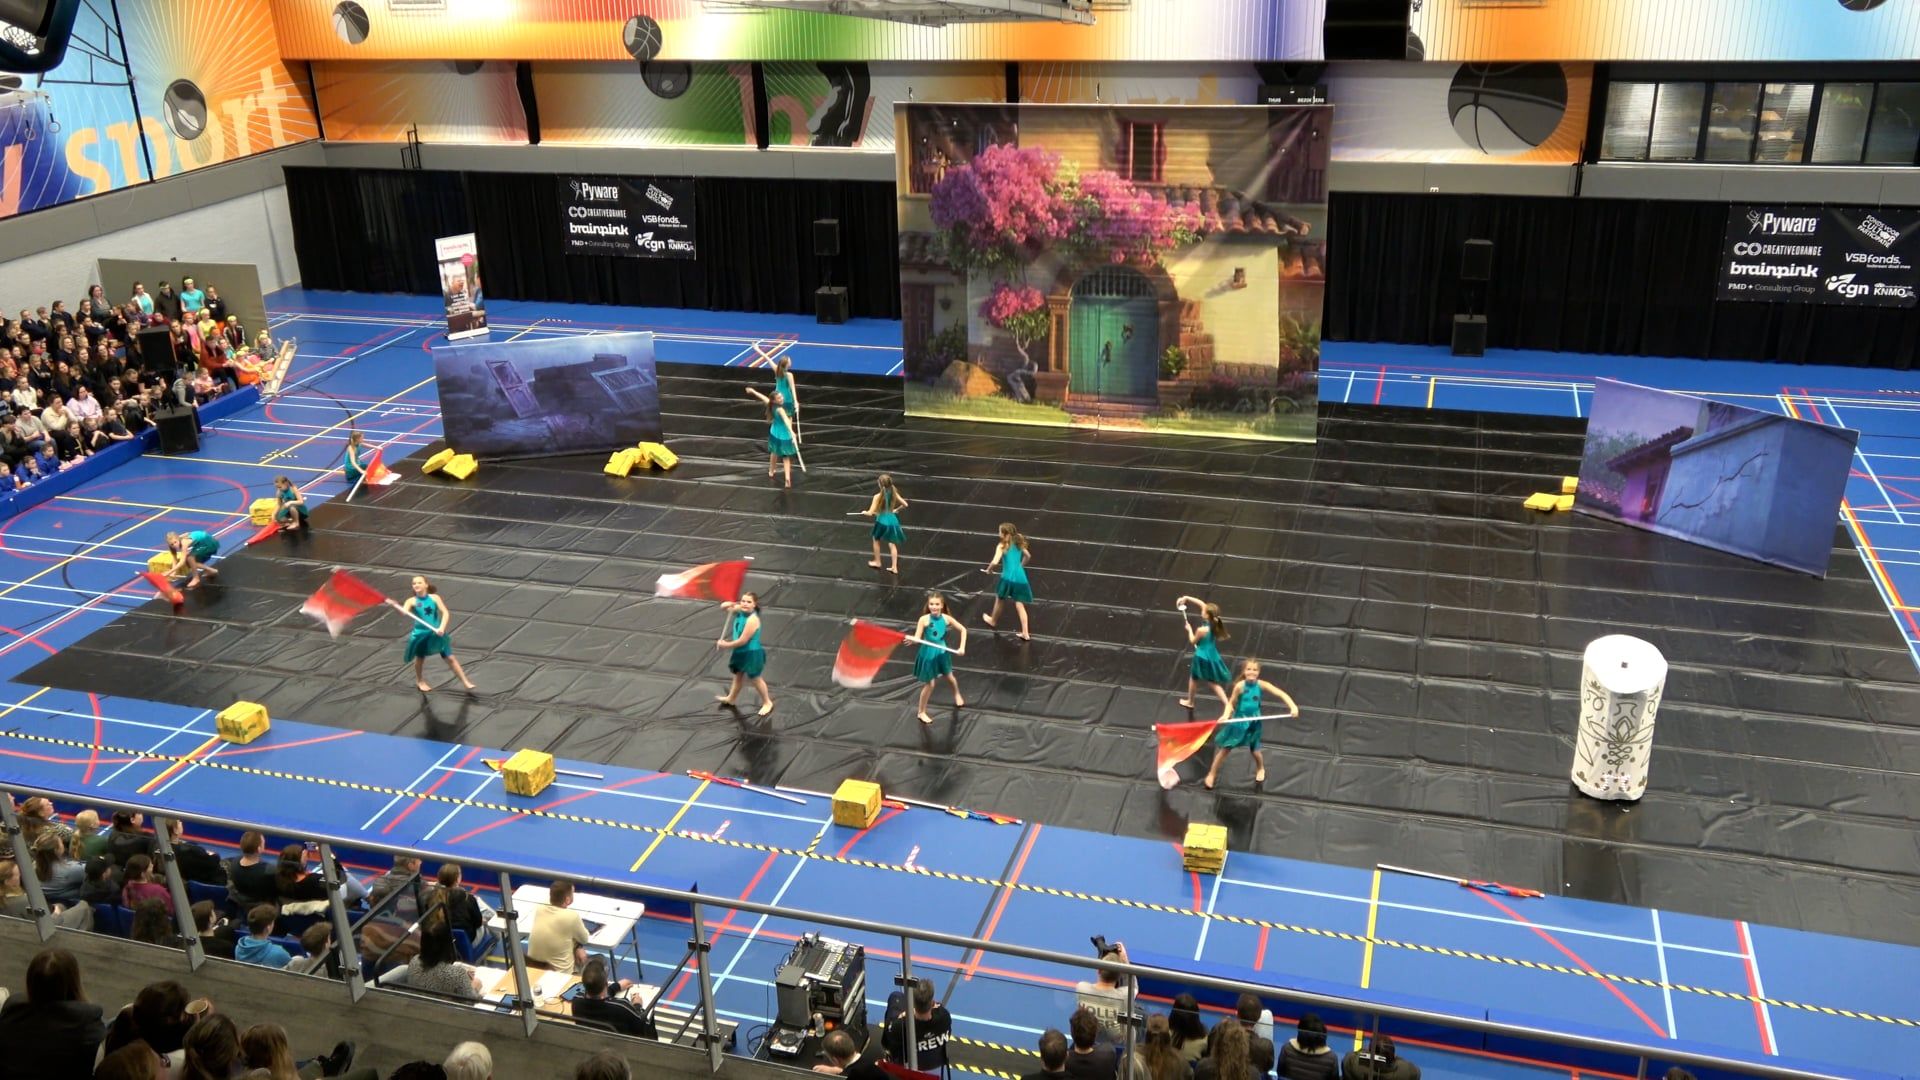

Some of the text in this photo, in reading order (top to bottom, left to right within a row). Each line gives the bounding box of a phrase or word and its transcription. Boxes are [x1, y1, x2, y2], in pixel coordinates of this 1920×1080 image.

[581, 182, 618, 200] Pyware
[568, 206, 587, 218] CO
[569, 222, 629, 236] brainpink
[1762, 213, 1817, 234] Pyware
[644, 240, 665, 252] cgn
[1733, 242, 1822, 256] CO CREATIVEORANGE
[1730, 261, 1819, 279] brainpink
[1728, 282, 1816, 294] PMD Consulting Group
[1837, 283, 1869, 298] cgn
[918, 1030, 949, 1052] REW
